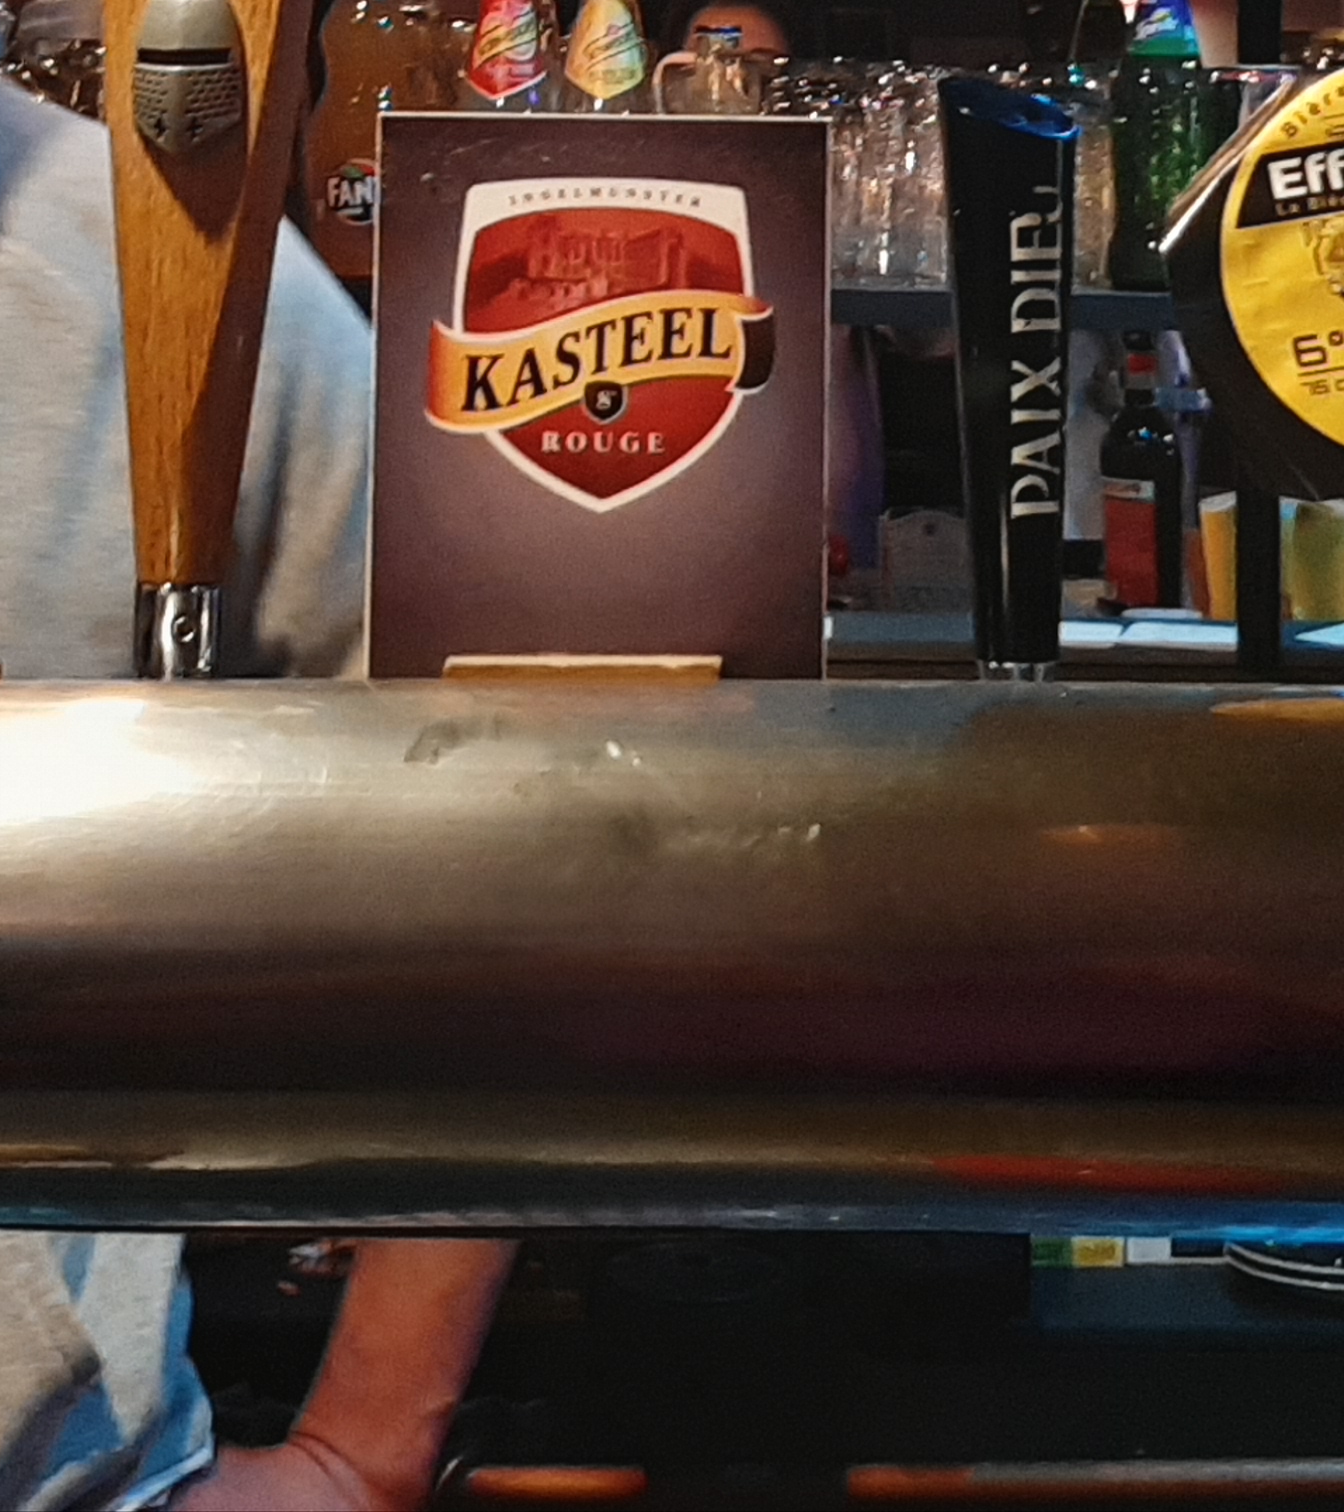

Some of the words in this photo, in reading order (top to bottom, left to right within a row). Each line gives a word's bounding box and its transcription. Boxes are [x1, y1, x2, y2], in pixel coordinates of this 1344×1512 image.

[327, 175, 374, 208] FAN
[460, 306, 732, 414] KASTEEL
[541, 430, 666, 455] ROUGE
[1010, 359, 1062, 520] PAIX
